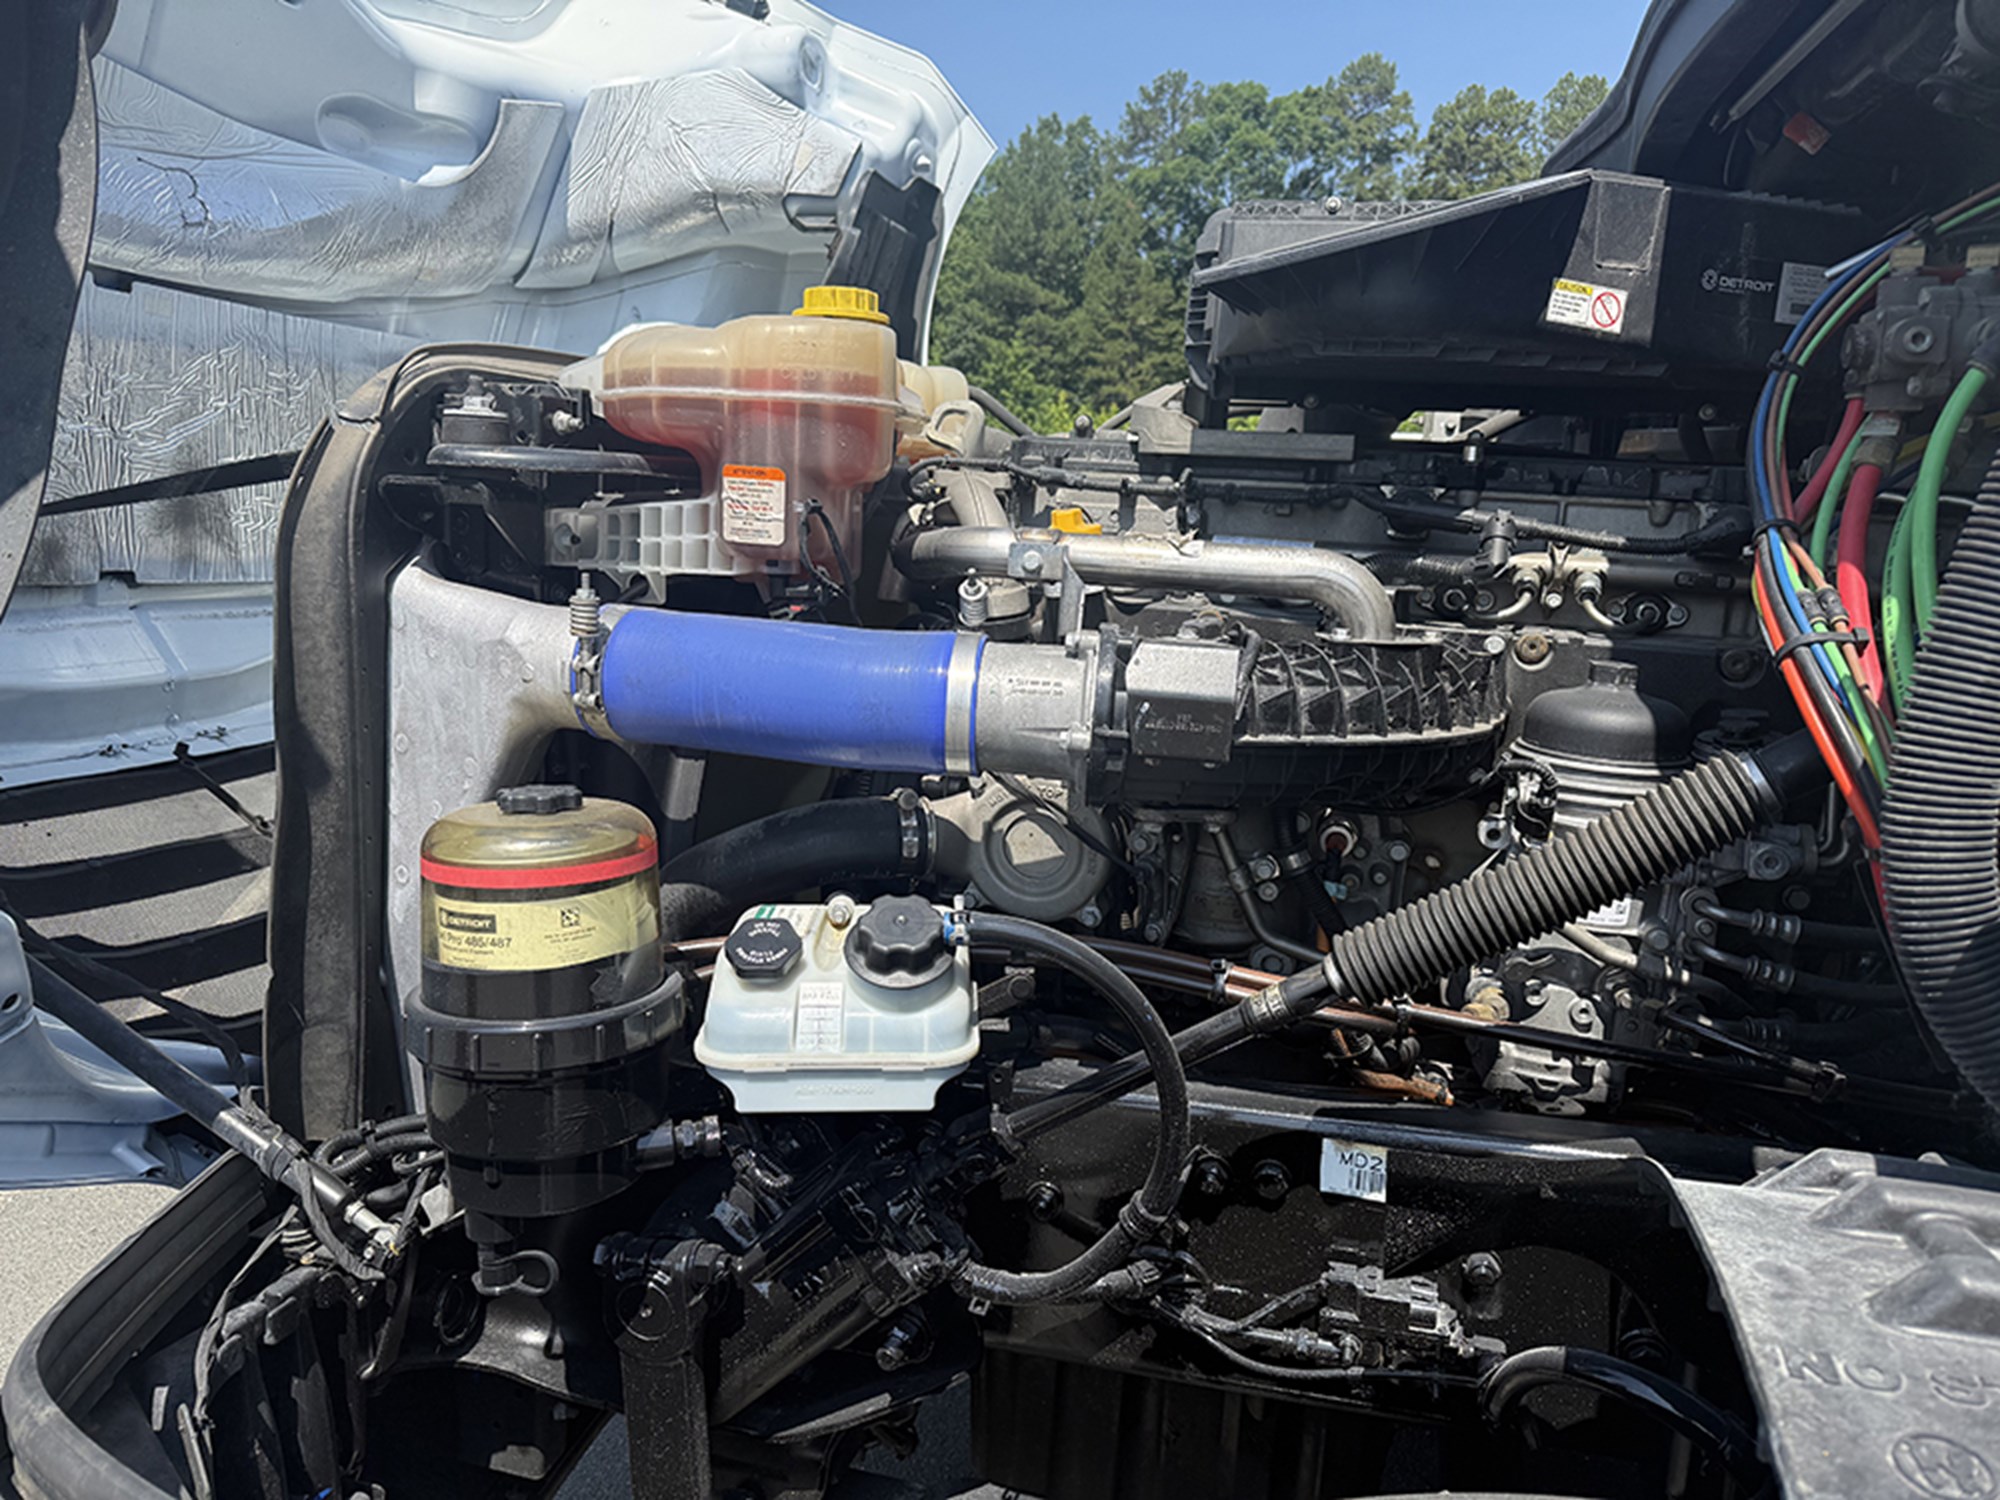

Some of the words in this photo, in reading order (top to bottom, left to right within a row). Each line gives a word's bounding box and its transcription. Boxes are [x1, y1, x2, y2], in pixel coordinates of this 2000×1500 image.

[1719, 275, 1775, 292] DETROIT
[447, 916, 493, 928] DETROIT
[465, 936, 513, 949] 485/487
[1339, 1152, 1383, 1172] MD2
